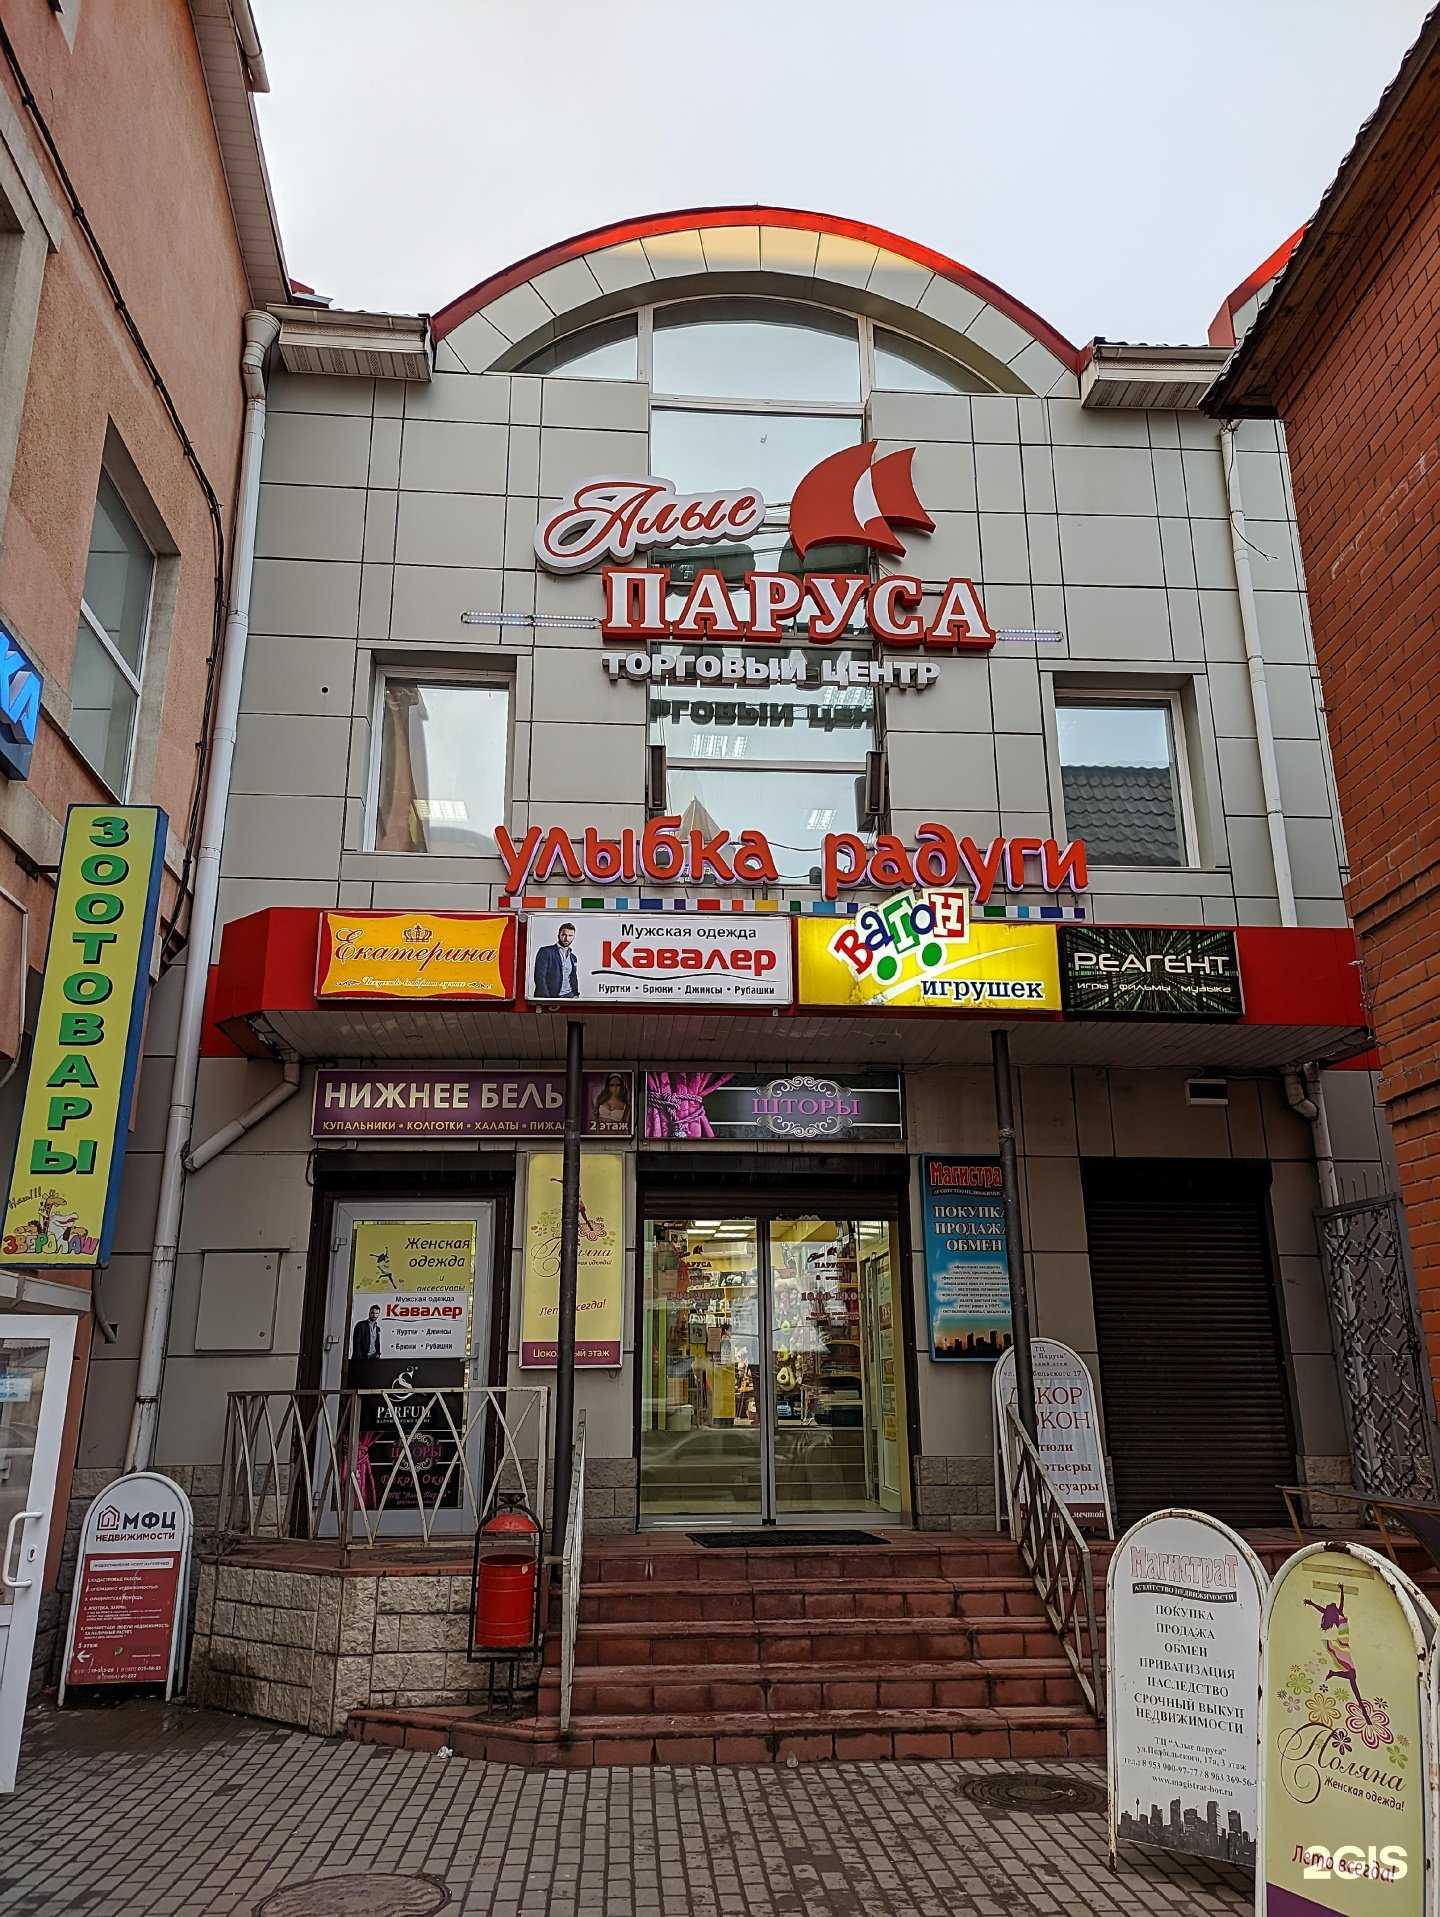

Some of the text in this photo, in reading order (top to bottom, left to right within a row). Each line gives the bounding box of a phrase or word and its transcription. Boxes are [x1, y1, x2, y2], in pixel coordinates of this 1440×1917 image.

[543, 480, 758, 558] Алые
[602, 566, 997, 650] ПАРУСА
[821, 659, 942, 689] ЦЕНТР
[494, 815, 1091, 904] улыбка радуги
[621, 924, 757, 940] Мужская одежда
[335, 929, 497, 971] Екатерина
[602, 940, 777, 976] Кавалер
[1073, 952, 1230, 975] РЕАГЕНТ
[30, 816, 130, 1175] ЗООТОВАРЫ
[598, 984, 775, 995] Куртки Брюки Джинсы Рубашки
[921, 979, 1044, 1000] игрушек
[324, 1082, 564, 1109] НИЖНЕЕ БЕЛЬ
[751, 1098, 861, 1116] ШТОРЫ
[322, 1121, 396, 1131] КУПАЛЬНИКИ
[406, 1120, 464, 1131] КОЛГОТКИ
[474, 1121, 519, 1131] ХАЛАТЫ
[590, 1121, 628, 1130] 2 этаж
[930, 1161, 1003, 1189] Магистра
[405, 1237, 471, 1250] Женская
[946, 1239, 1002, 1251] ОБМЕН
[409, 1255, 465, 1268] одежда
[386, 1304, 463, 1319] Кавалер
[576, 1299, 607, 1312] сегда!
[588, 1350, 610, 1358] этаж
[1035, 1411, 1092, 1430] КОН
[122, 1512, 177, 1530] МФЦ
[95, 1532, 175, 1542] НЕДВИЖИМОСТИ
[1130, 1546, 1239, 1588] Магистрат
[1155, 1605, 1215, 1621] ПОКУПКА
[1156, 1622, 1216, 1640] ПРОДАЖА
[1164, 1642, 1208, 1658] ОБМЕН
[1139, 1657, 1236, 1680] ПРИВАТИЗАЦИЯ
[1147, 1676, 1229, 1698] НАСЛЕДСТВО
[1134, 1692, 1245, 1719] СРОЧНЫЙ ВЫКУП
[1136, 1707, 1244, 1735] НЕДВИЖИМОСТИ
[1277, 1723, 1406, 1804] Поляна
[1324, 1776, 1405, 1812] Женская одежда!
[1292, 1845, 1334, 1868] Лето
